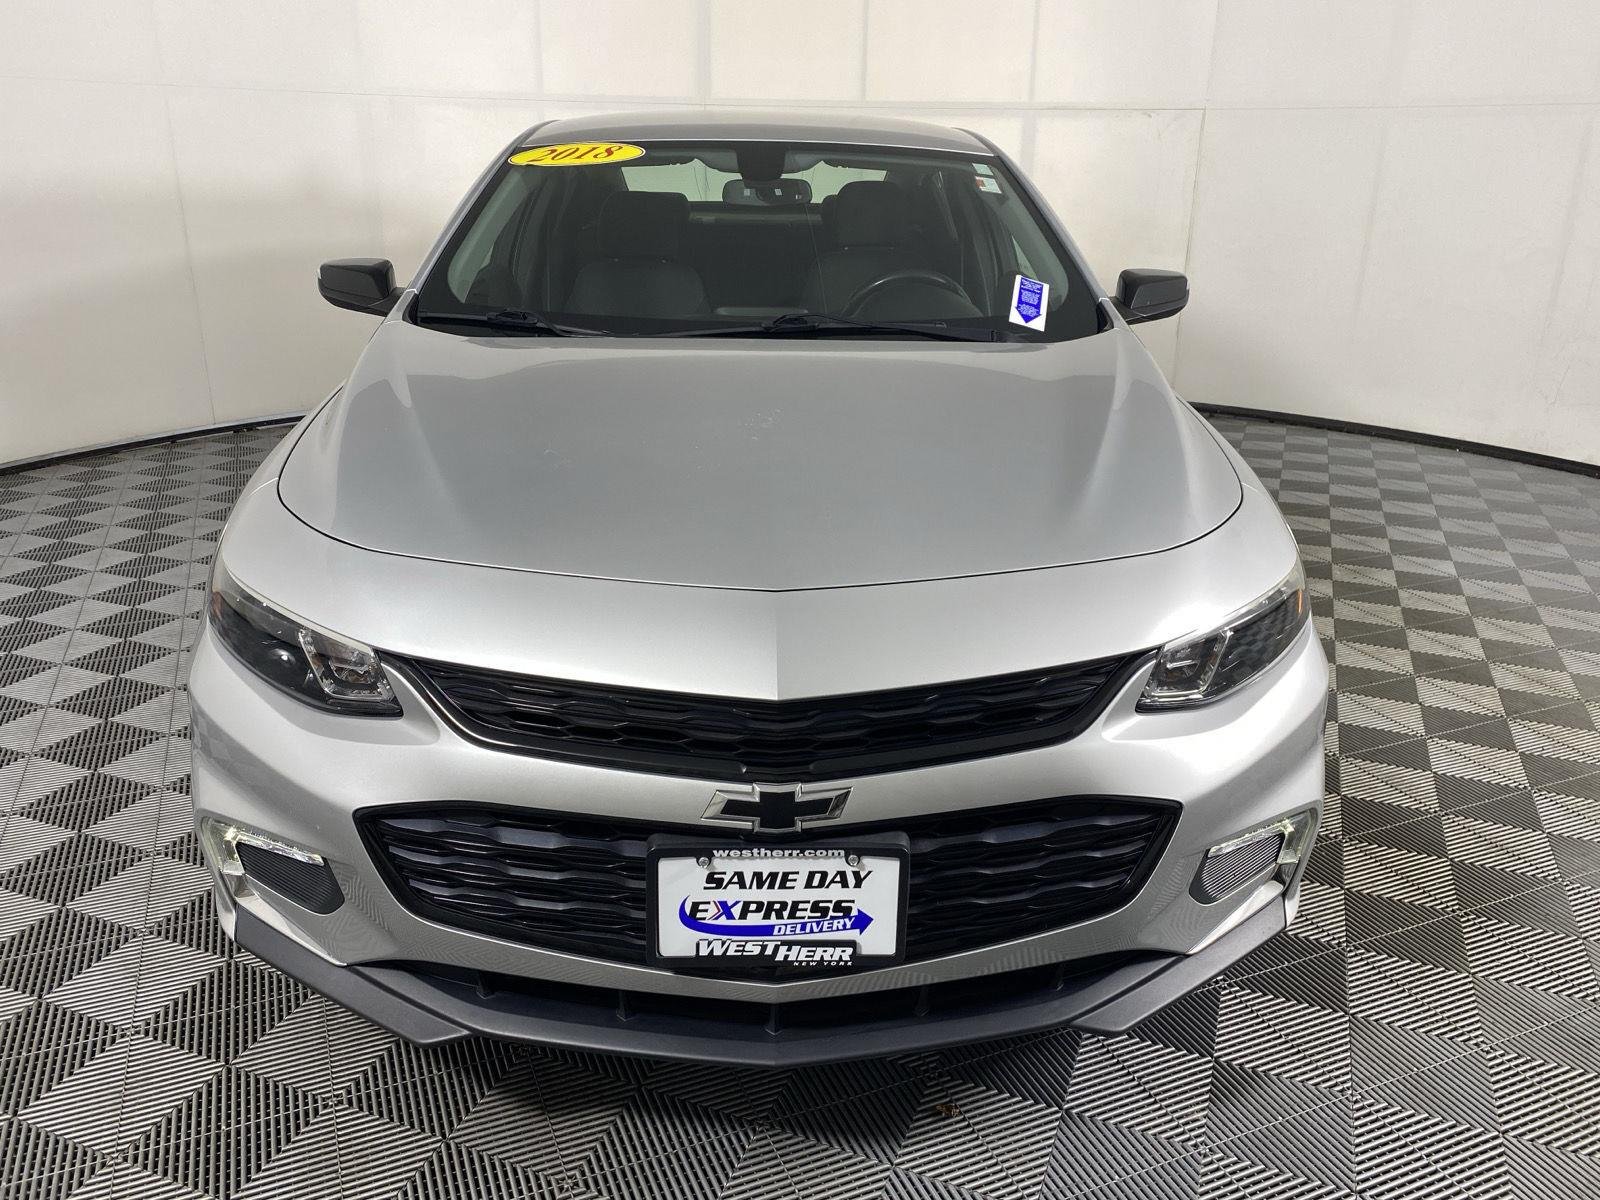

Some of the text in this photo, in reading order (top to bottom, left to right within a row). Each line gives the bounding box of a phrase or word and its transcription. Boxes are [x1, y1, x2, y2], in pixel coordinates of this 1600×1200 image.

[526, 145, 623, 162] 2018
[712, 848, 845, 858] westherr.com
[703, 870, 874, 891] SAME DAY
[687, 899, 856, 921] EXPRESS
[772, 917, 856, 936] DELIVERY
[698, 938, 854, 962] WEST HERR
